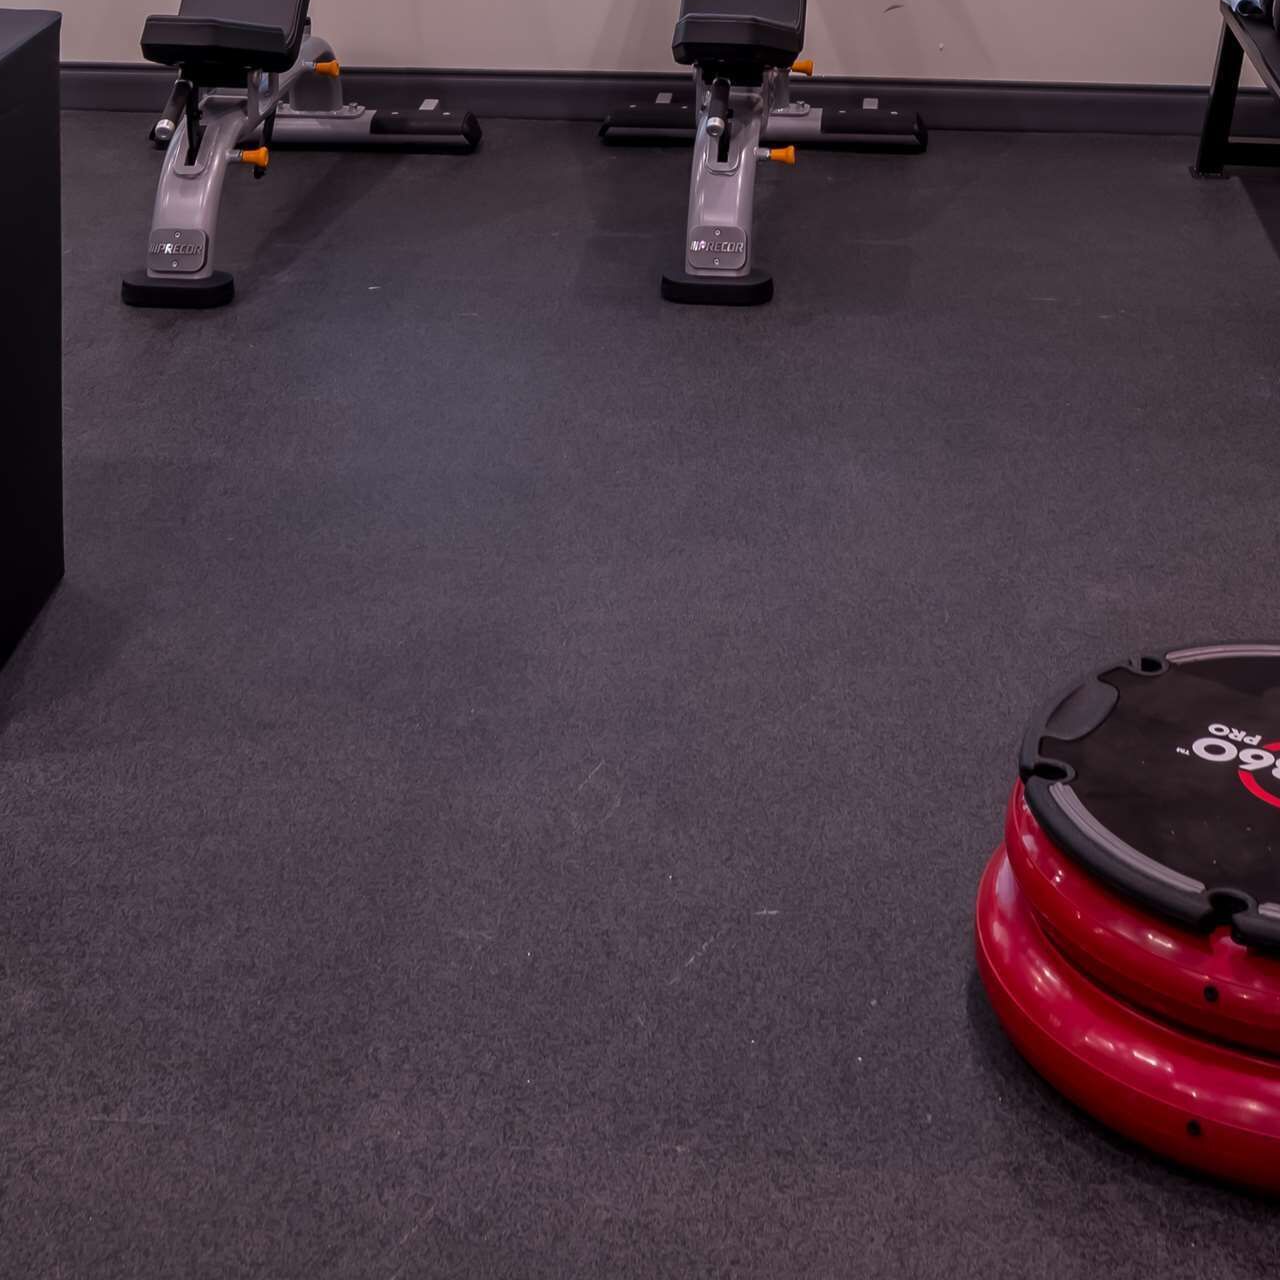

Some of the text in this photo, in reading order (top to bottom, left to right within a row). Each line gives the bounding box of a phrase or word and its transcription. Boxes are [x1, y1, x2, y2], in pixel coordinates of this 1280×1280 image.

[157, 243, 203, 254] PRECOR
[697, 240, 745, 253] PRECOR
[1207, 723, 1263, 747] PRO
